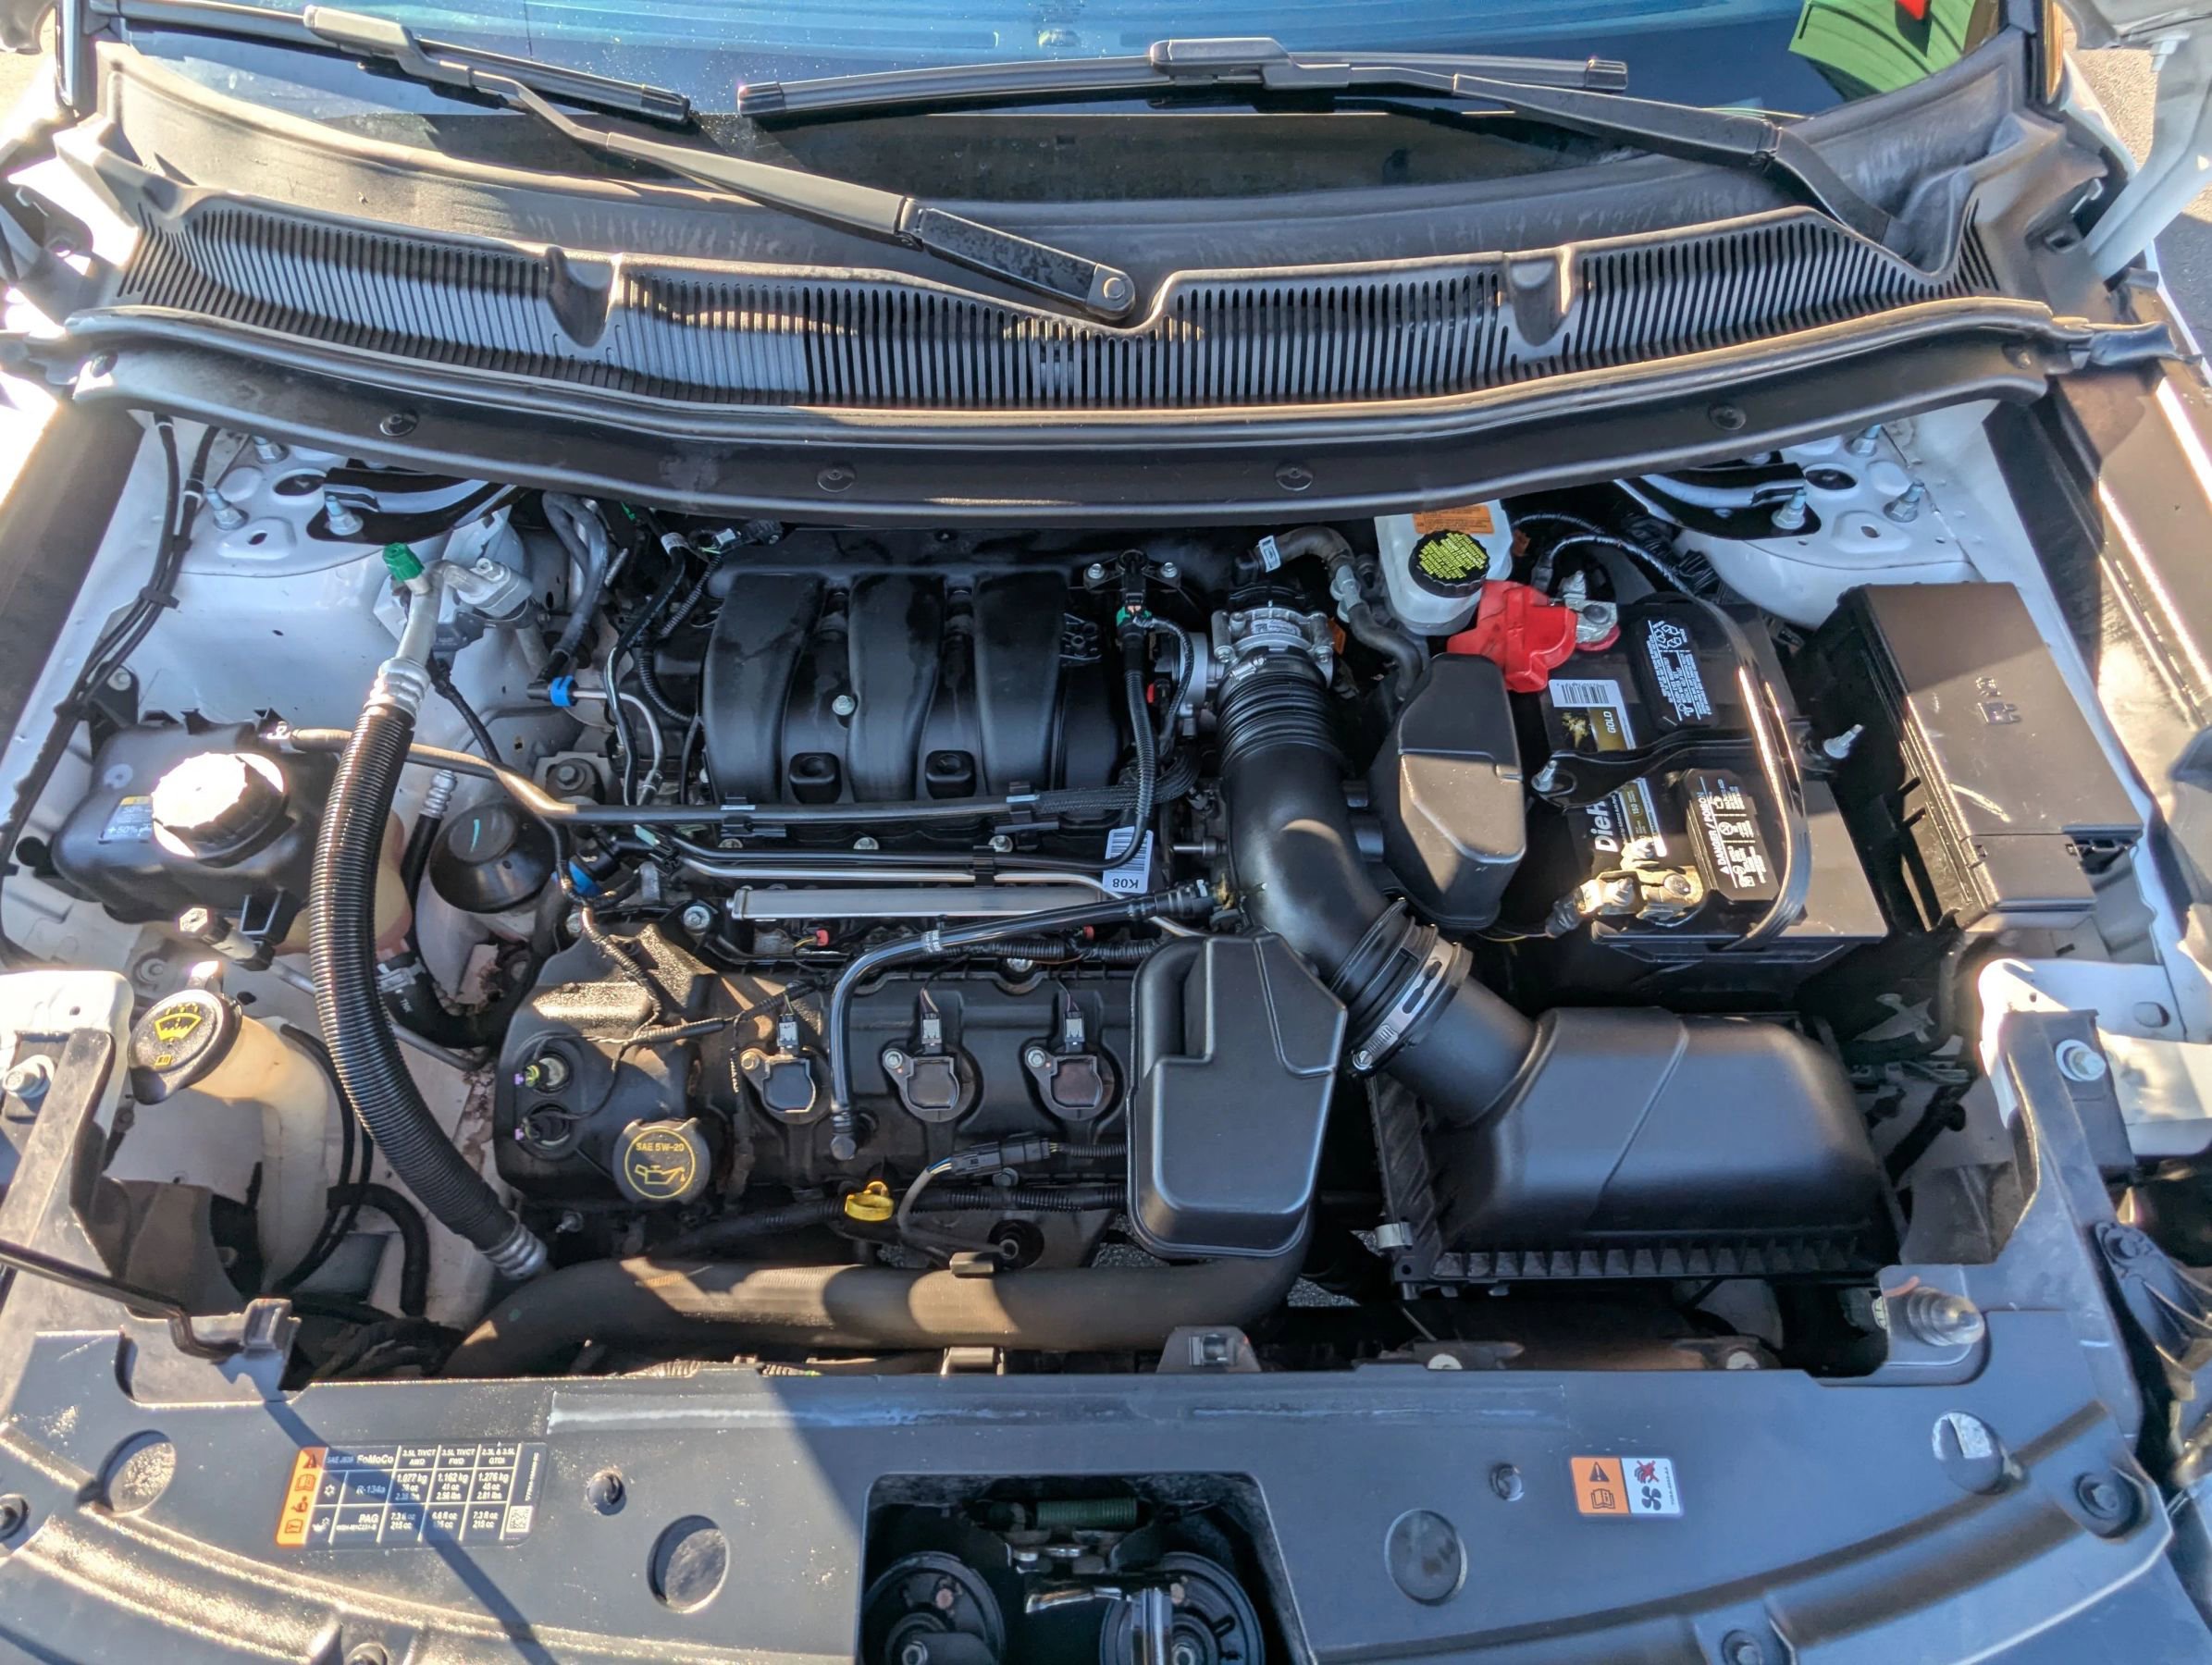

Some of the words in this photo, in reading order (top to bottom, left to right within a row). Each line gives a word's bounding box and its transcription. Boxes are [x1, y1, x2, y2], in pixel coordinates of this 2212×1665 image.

[1603, 710, 1616, 734] GOLD
[1631, 804, 1639, 814] 150
[1697, 792, 1712, 821] POISON
[1708, 830, 1726, 866] DANGER
[1112, 879, 1138, 888] K08
[636, 1142, 653, 1151] SAE
[655, 1142, 685, 1152] 5W-20
[357, 1454, 394, 1465] FoMoCo
[398, 1473, 416, 1483] 1.077
[417, 1473, 428, 1486] kg
[439, 1473, 457, 1482] 1.162
[459, 1473, 468, 1484] kg
[479, 1473, 498, 1482] 1.276
[499, 1473, 509, 1484] kg
[355, 1485, 385, 1495] R-134a
[359, 1513, 379, 1523] PAG
